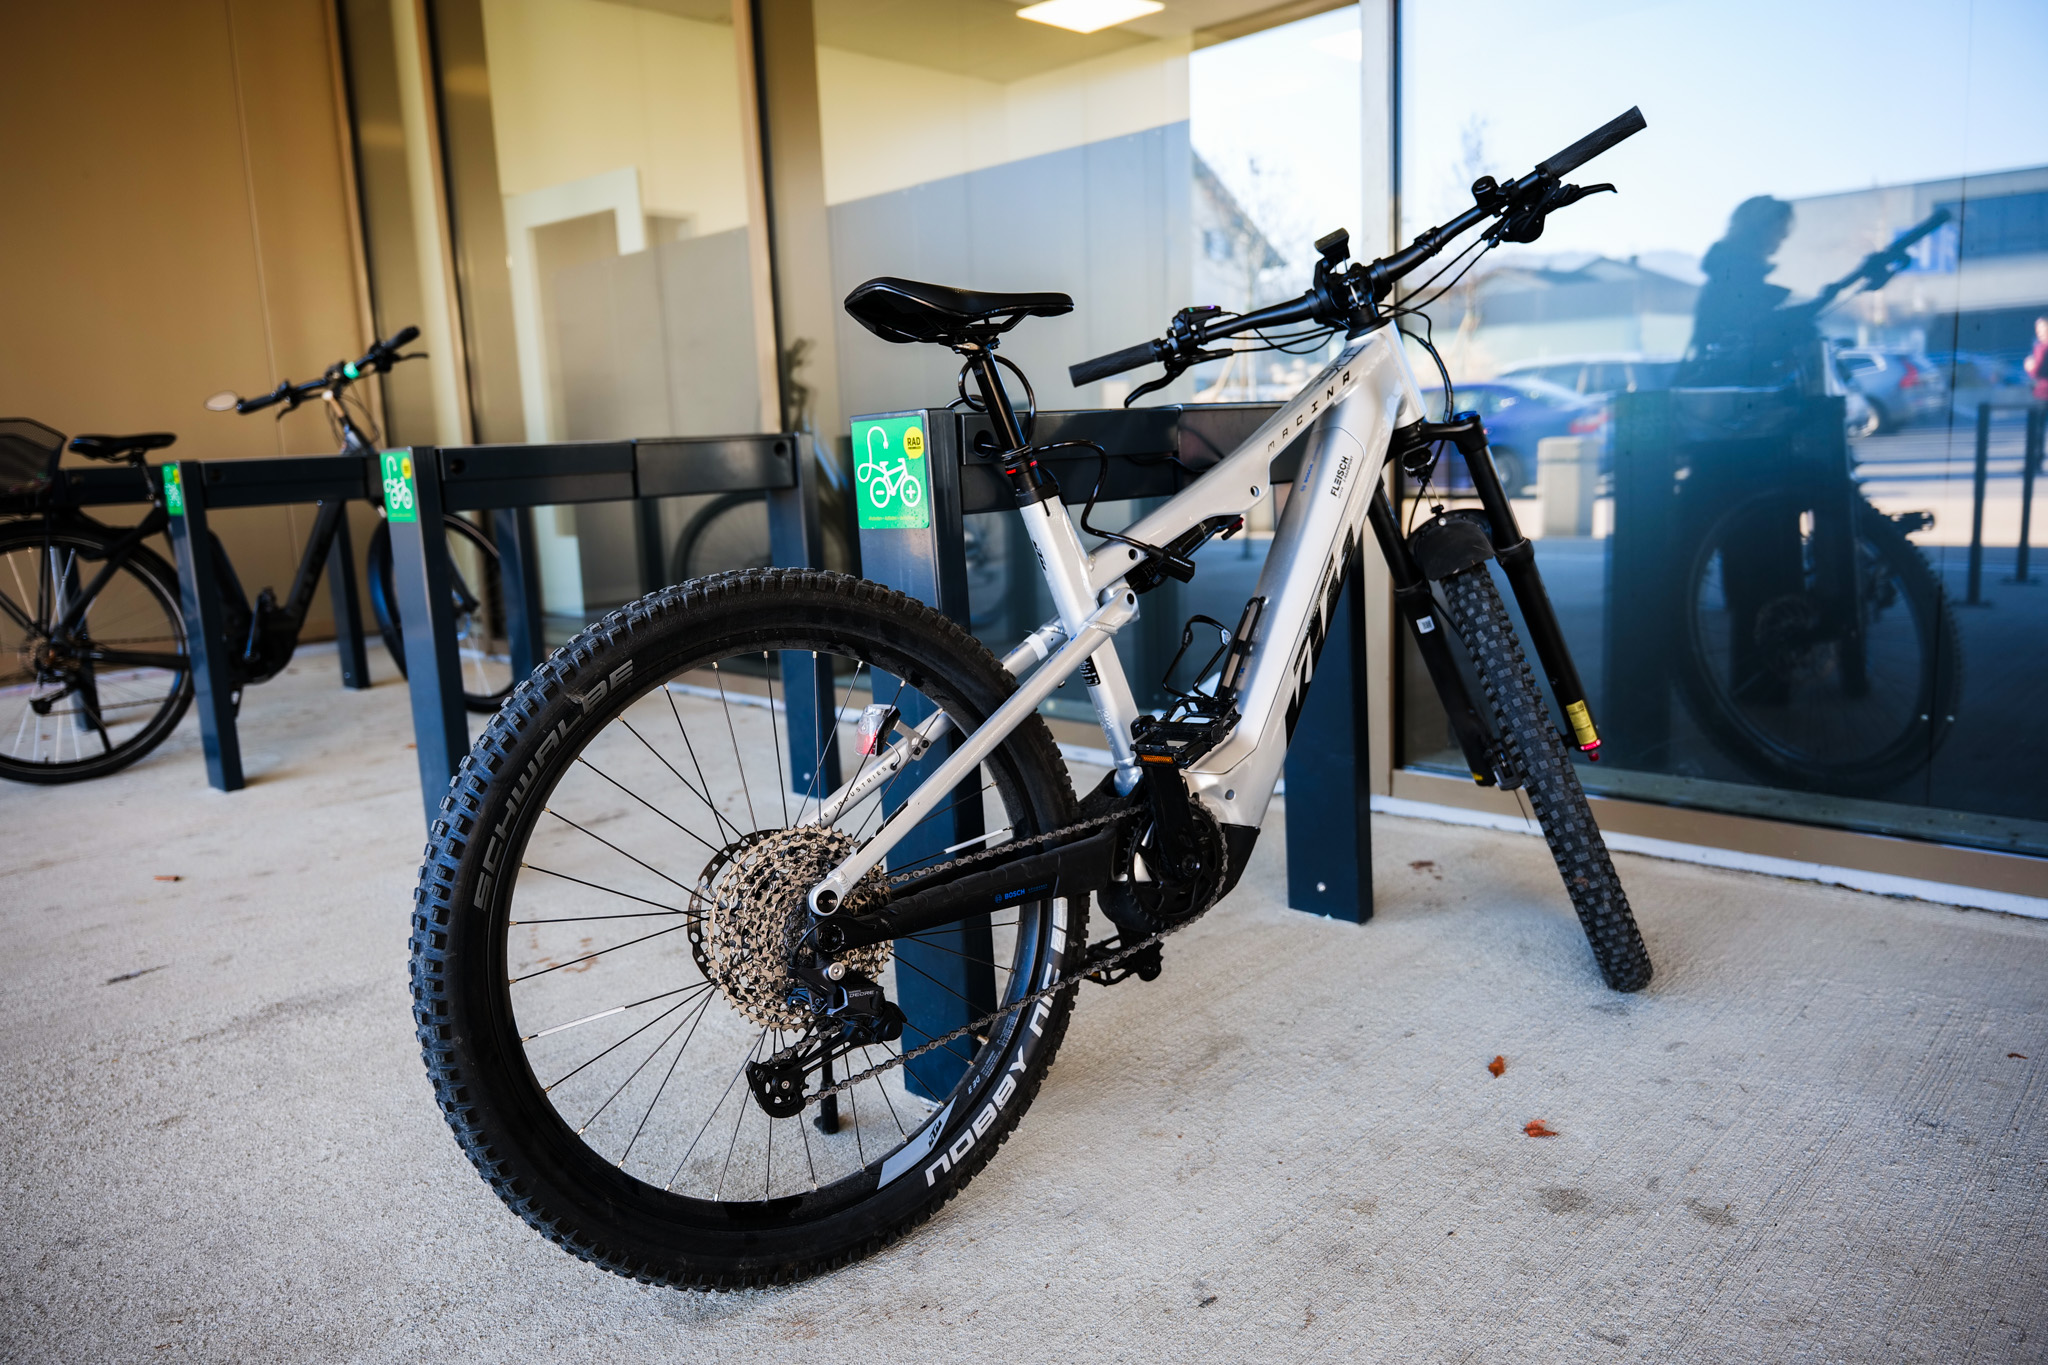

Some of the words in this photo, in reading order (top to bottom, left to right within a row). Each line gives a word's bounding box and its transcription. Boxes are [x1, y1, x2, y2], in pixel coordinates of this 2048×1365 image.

[1267, 370, 1350, 453] MACINA
[907, 437, 921, 446] RAD
[1330, 456, 1349, 497] FLEISCH
[474, 659, 634, 912] SCHWALBE
[833, 765, 887, 810] INDUSTRIES
[1004, 888, 1026, 900] BOSCH
[848, 990, 875, 998] DEORE
[925, 1045, 1027, 1187] NOBBY
